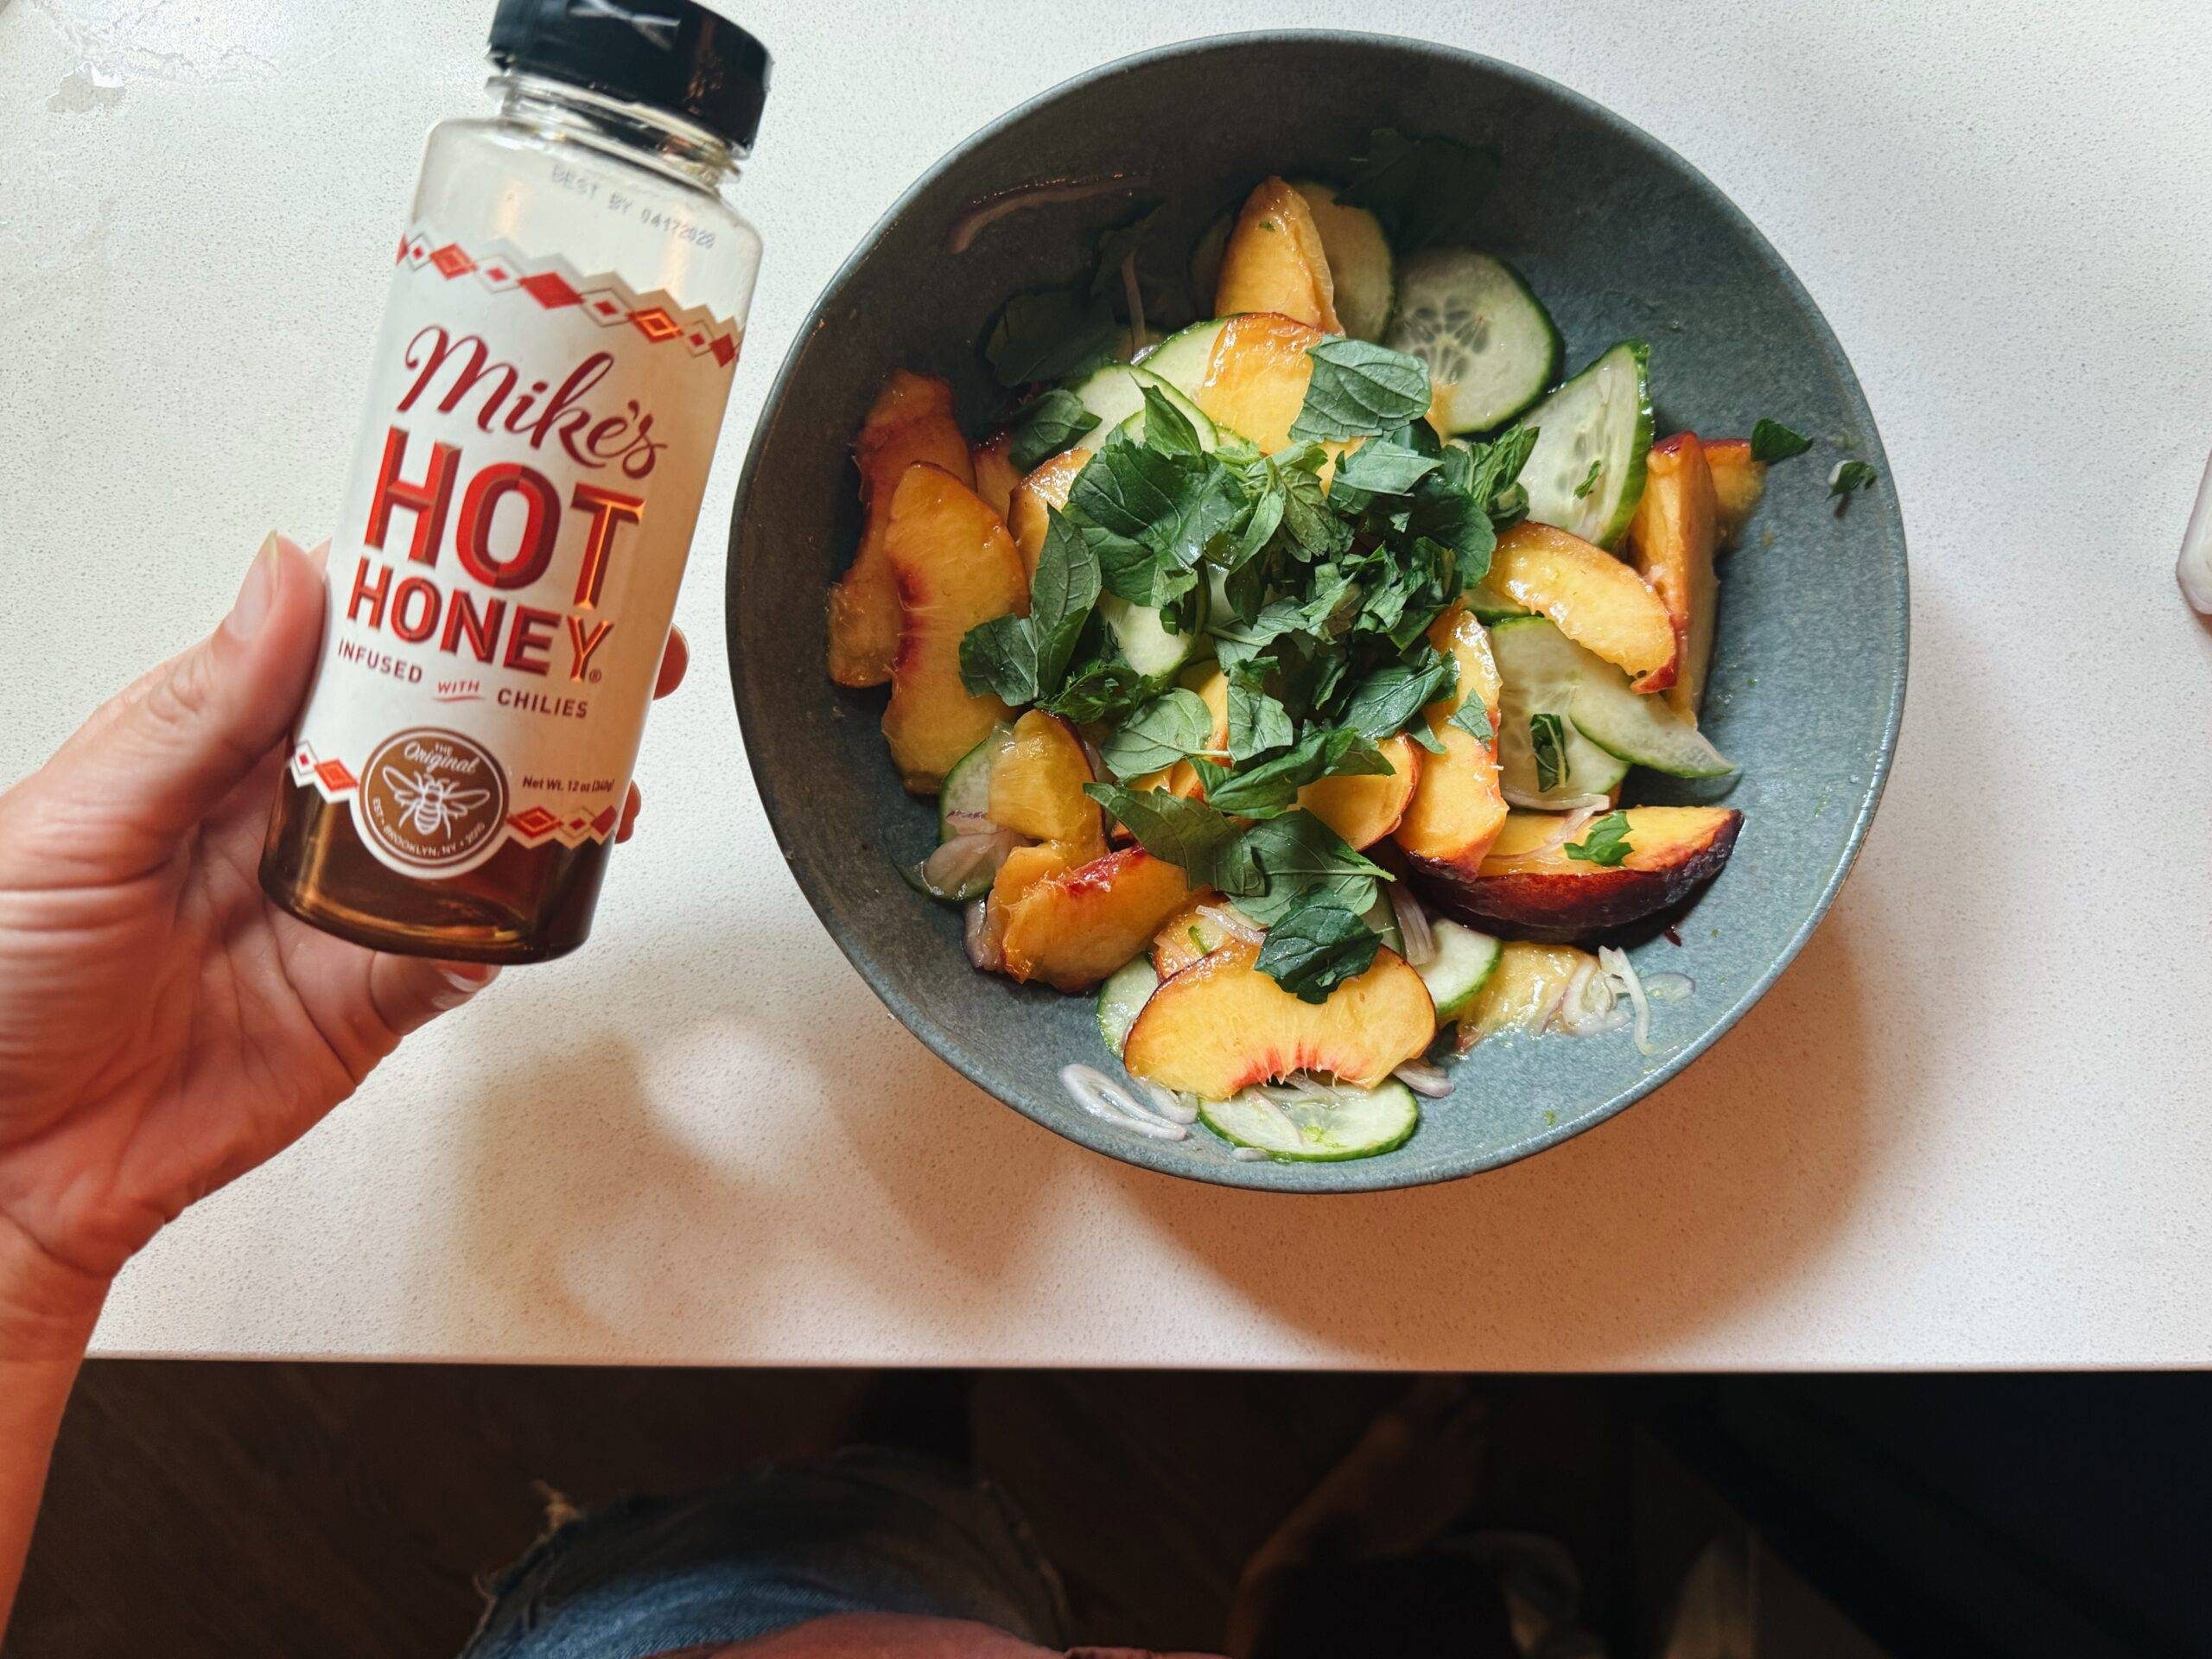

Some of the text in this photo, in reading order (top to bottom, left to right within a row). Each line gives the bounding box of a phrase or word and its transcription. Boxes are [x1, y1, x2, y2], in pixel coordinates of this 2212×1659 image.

[551, 164, 599, 199] BEST
[608, 191, 633, 214] BY
[397, 325, 668, 480] Mike's
[364, 424, 646, 611] HOT
[338, 639, 588, 719] INFUSED WITH CHILIES
[404, 741, 480, 775] Original
[522, 775, 543, 790] Net
[568, 779, 579, 792] 12
